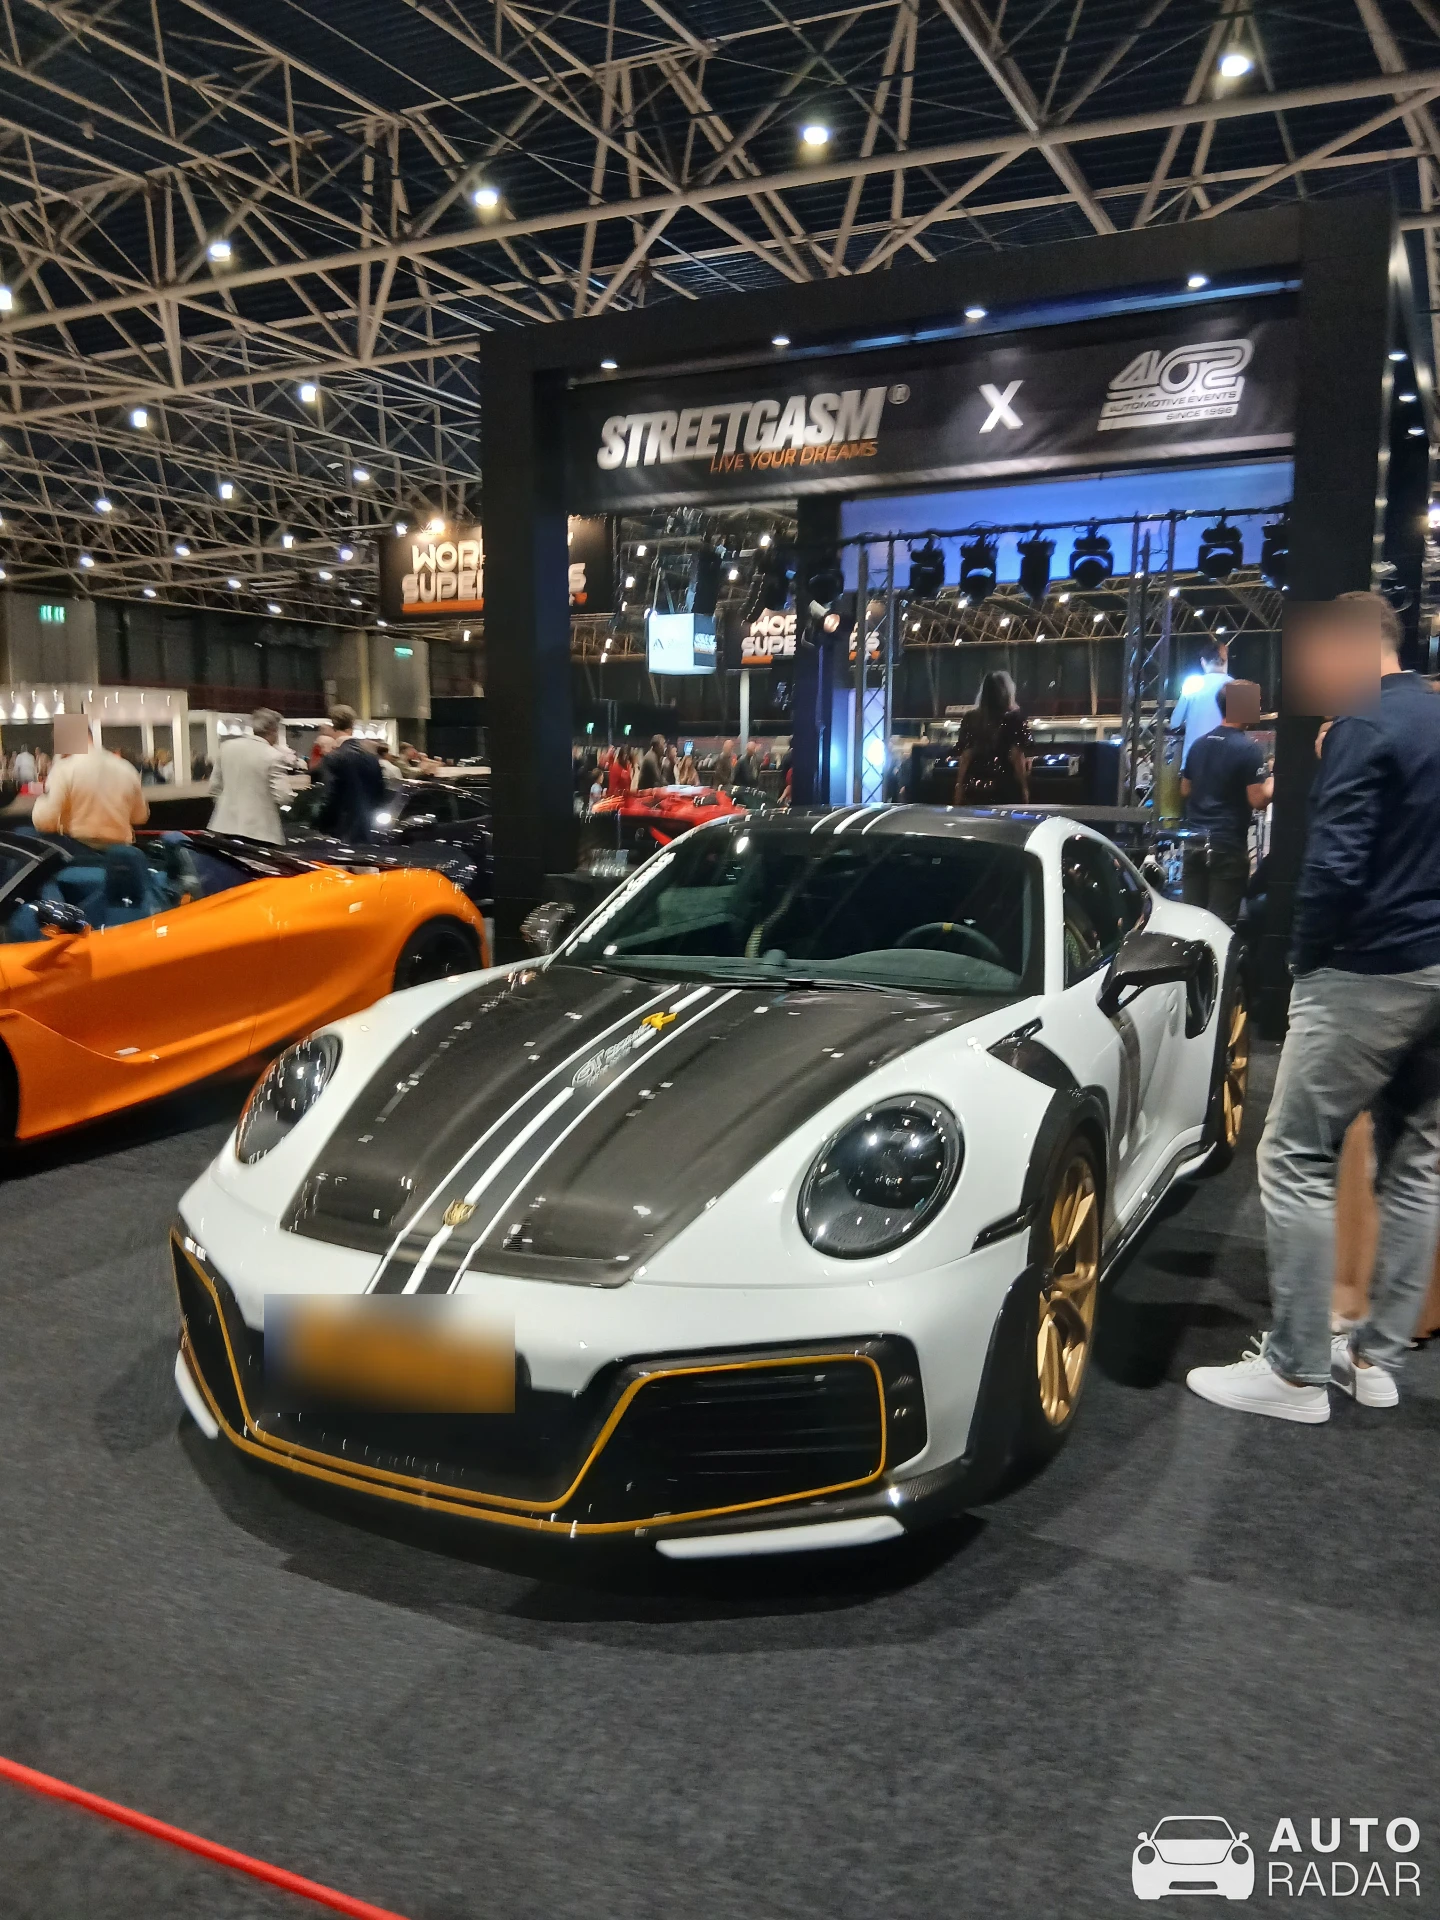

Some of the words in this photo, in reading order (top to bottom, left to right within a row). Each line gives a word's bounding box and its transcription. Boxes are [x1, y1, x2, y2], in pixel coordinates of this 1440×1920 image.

[978, 380, 1024, 433] X
[1188, 391, 1237, 404] EVENTS
[1166, 409, 1201, 420] SINCE
[710, 453, 746, 473] LIVE
[749, 447, 798, 470] YOUR
[800, 441, 879, 466] DREAMS
